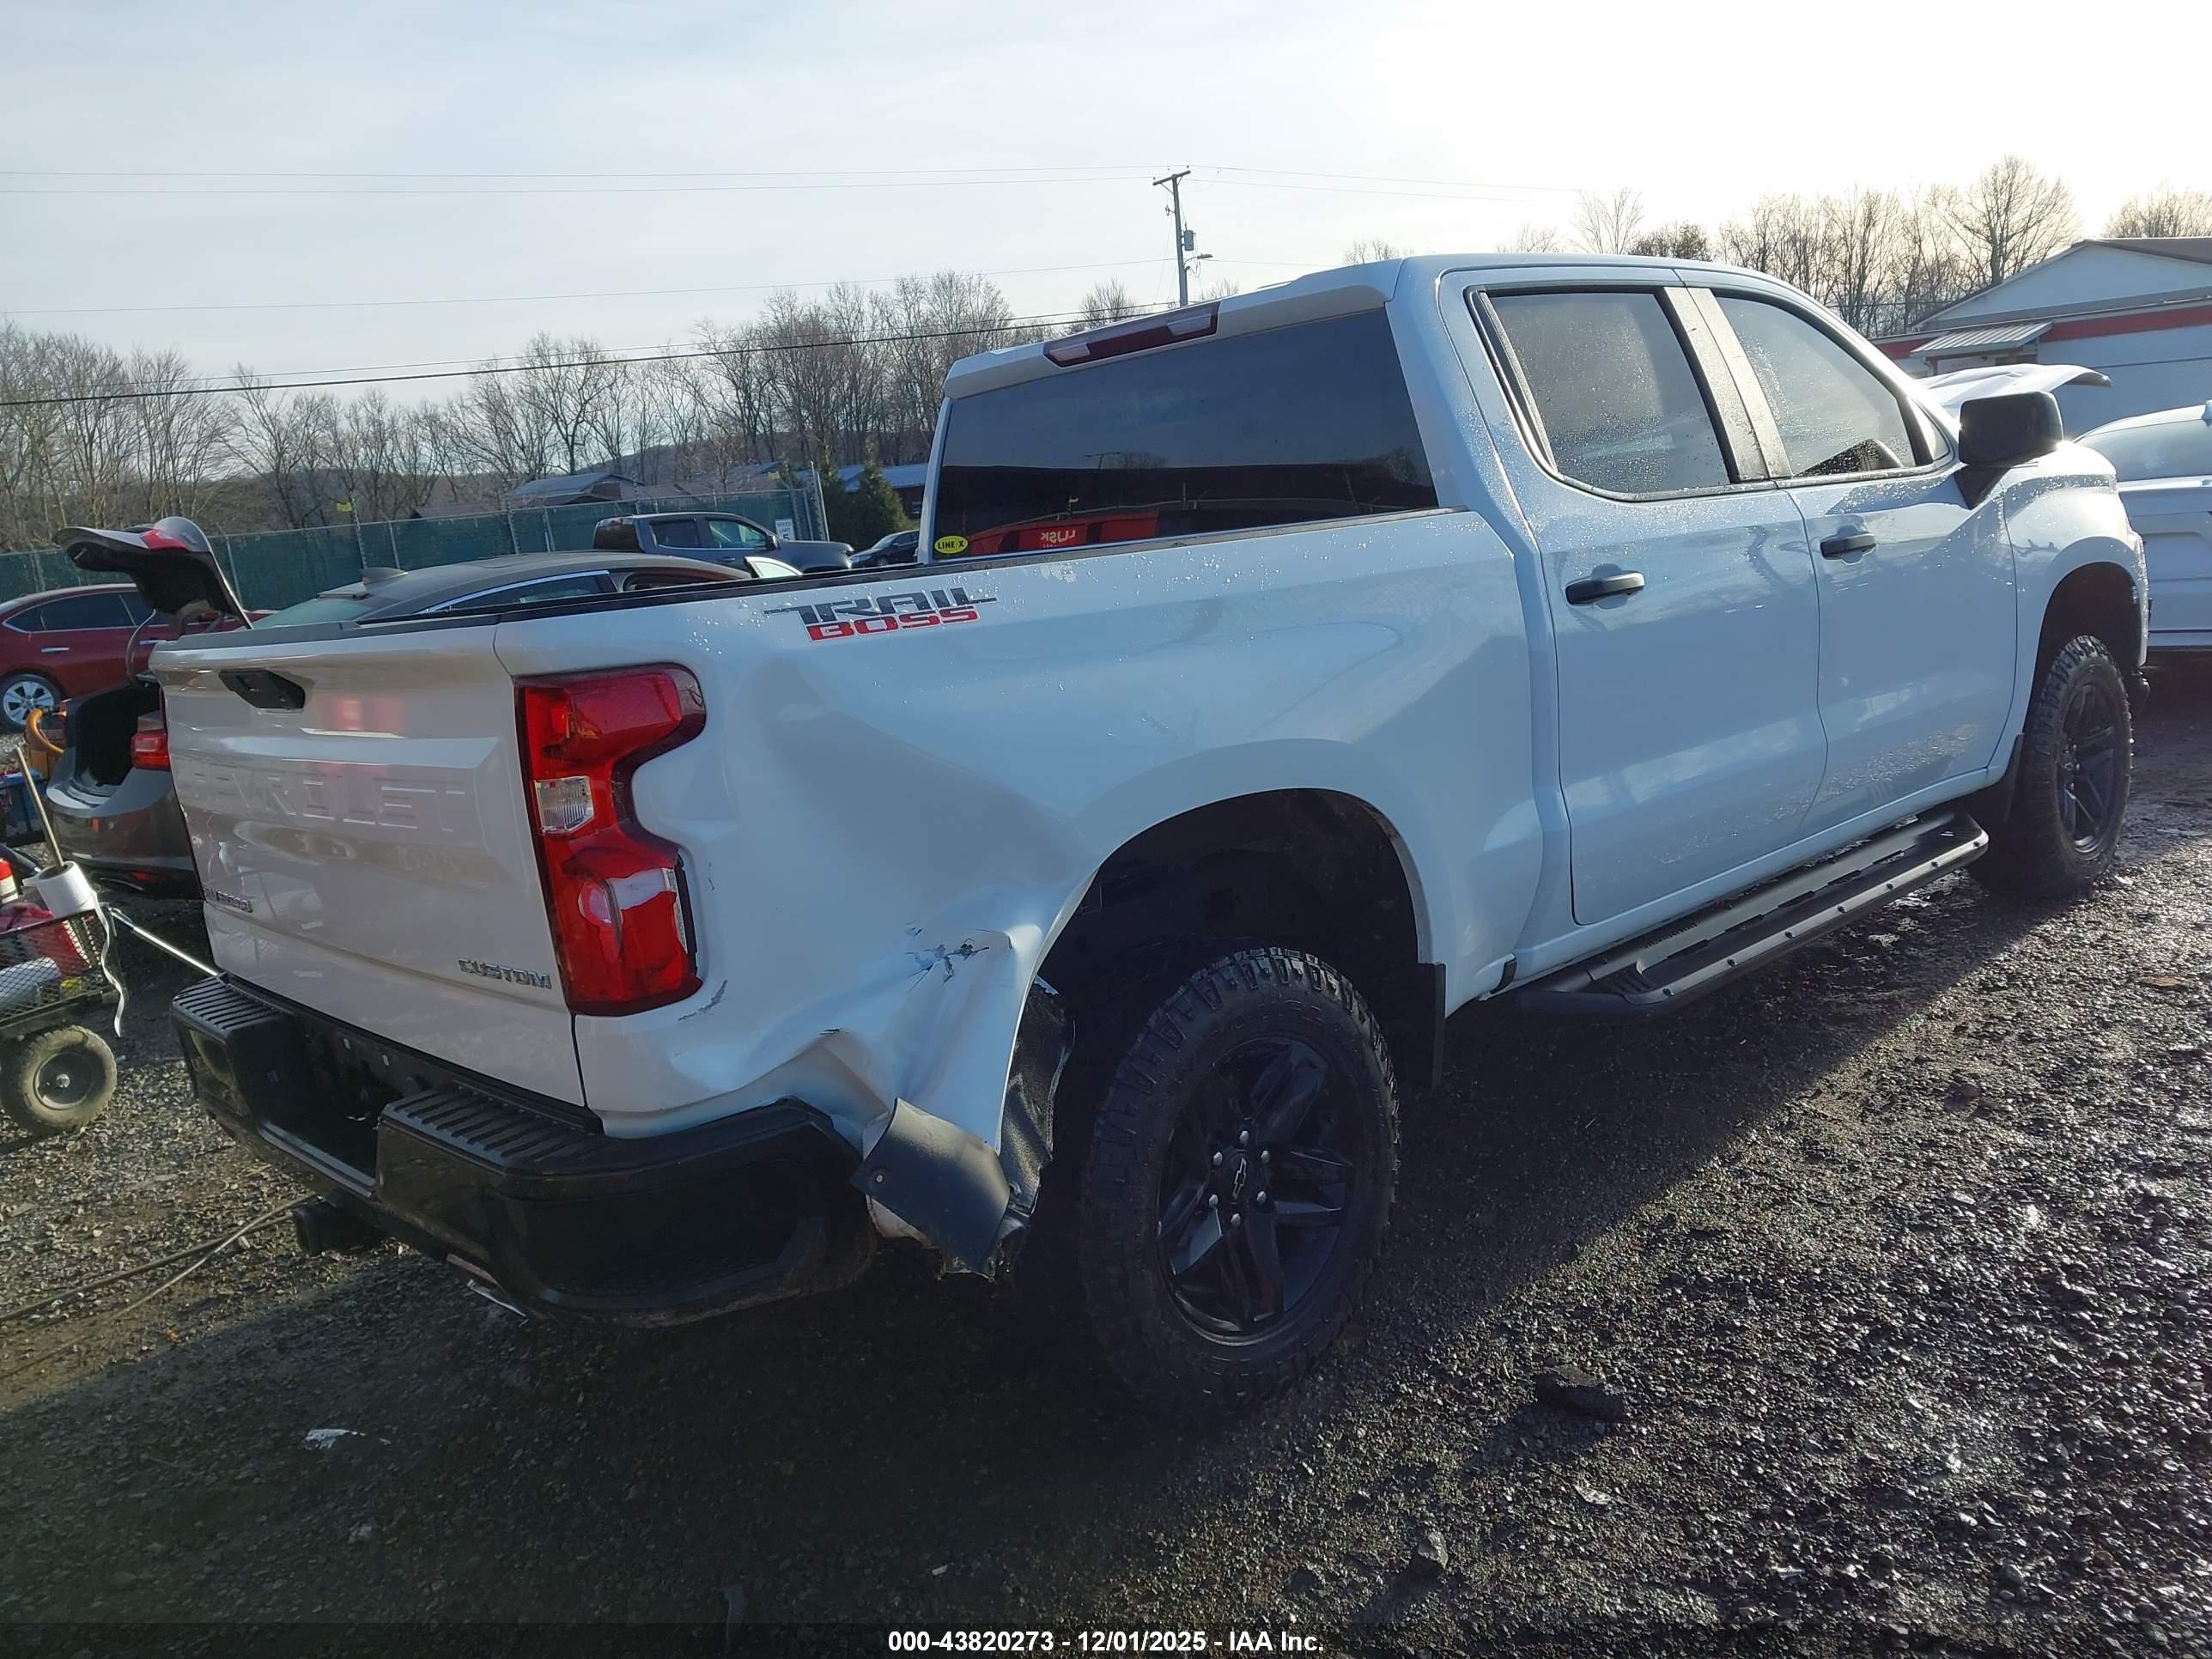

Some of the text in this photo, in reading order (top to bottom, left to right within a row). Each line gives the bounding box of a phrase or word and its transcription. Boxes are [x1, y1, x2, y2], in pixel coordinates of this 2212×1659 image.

[763, 587, 998, 625] TRAIL
[805, 605, 980, 642] BOSS
[457, 957, 552, 990] CUSTOM
